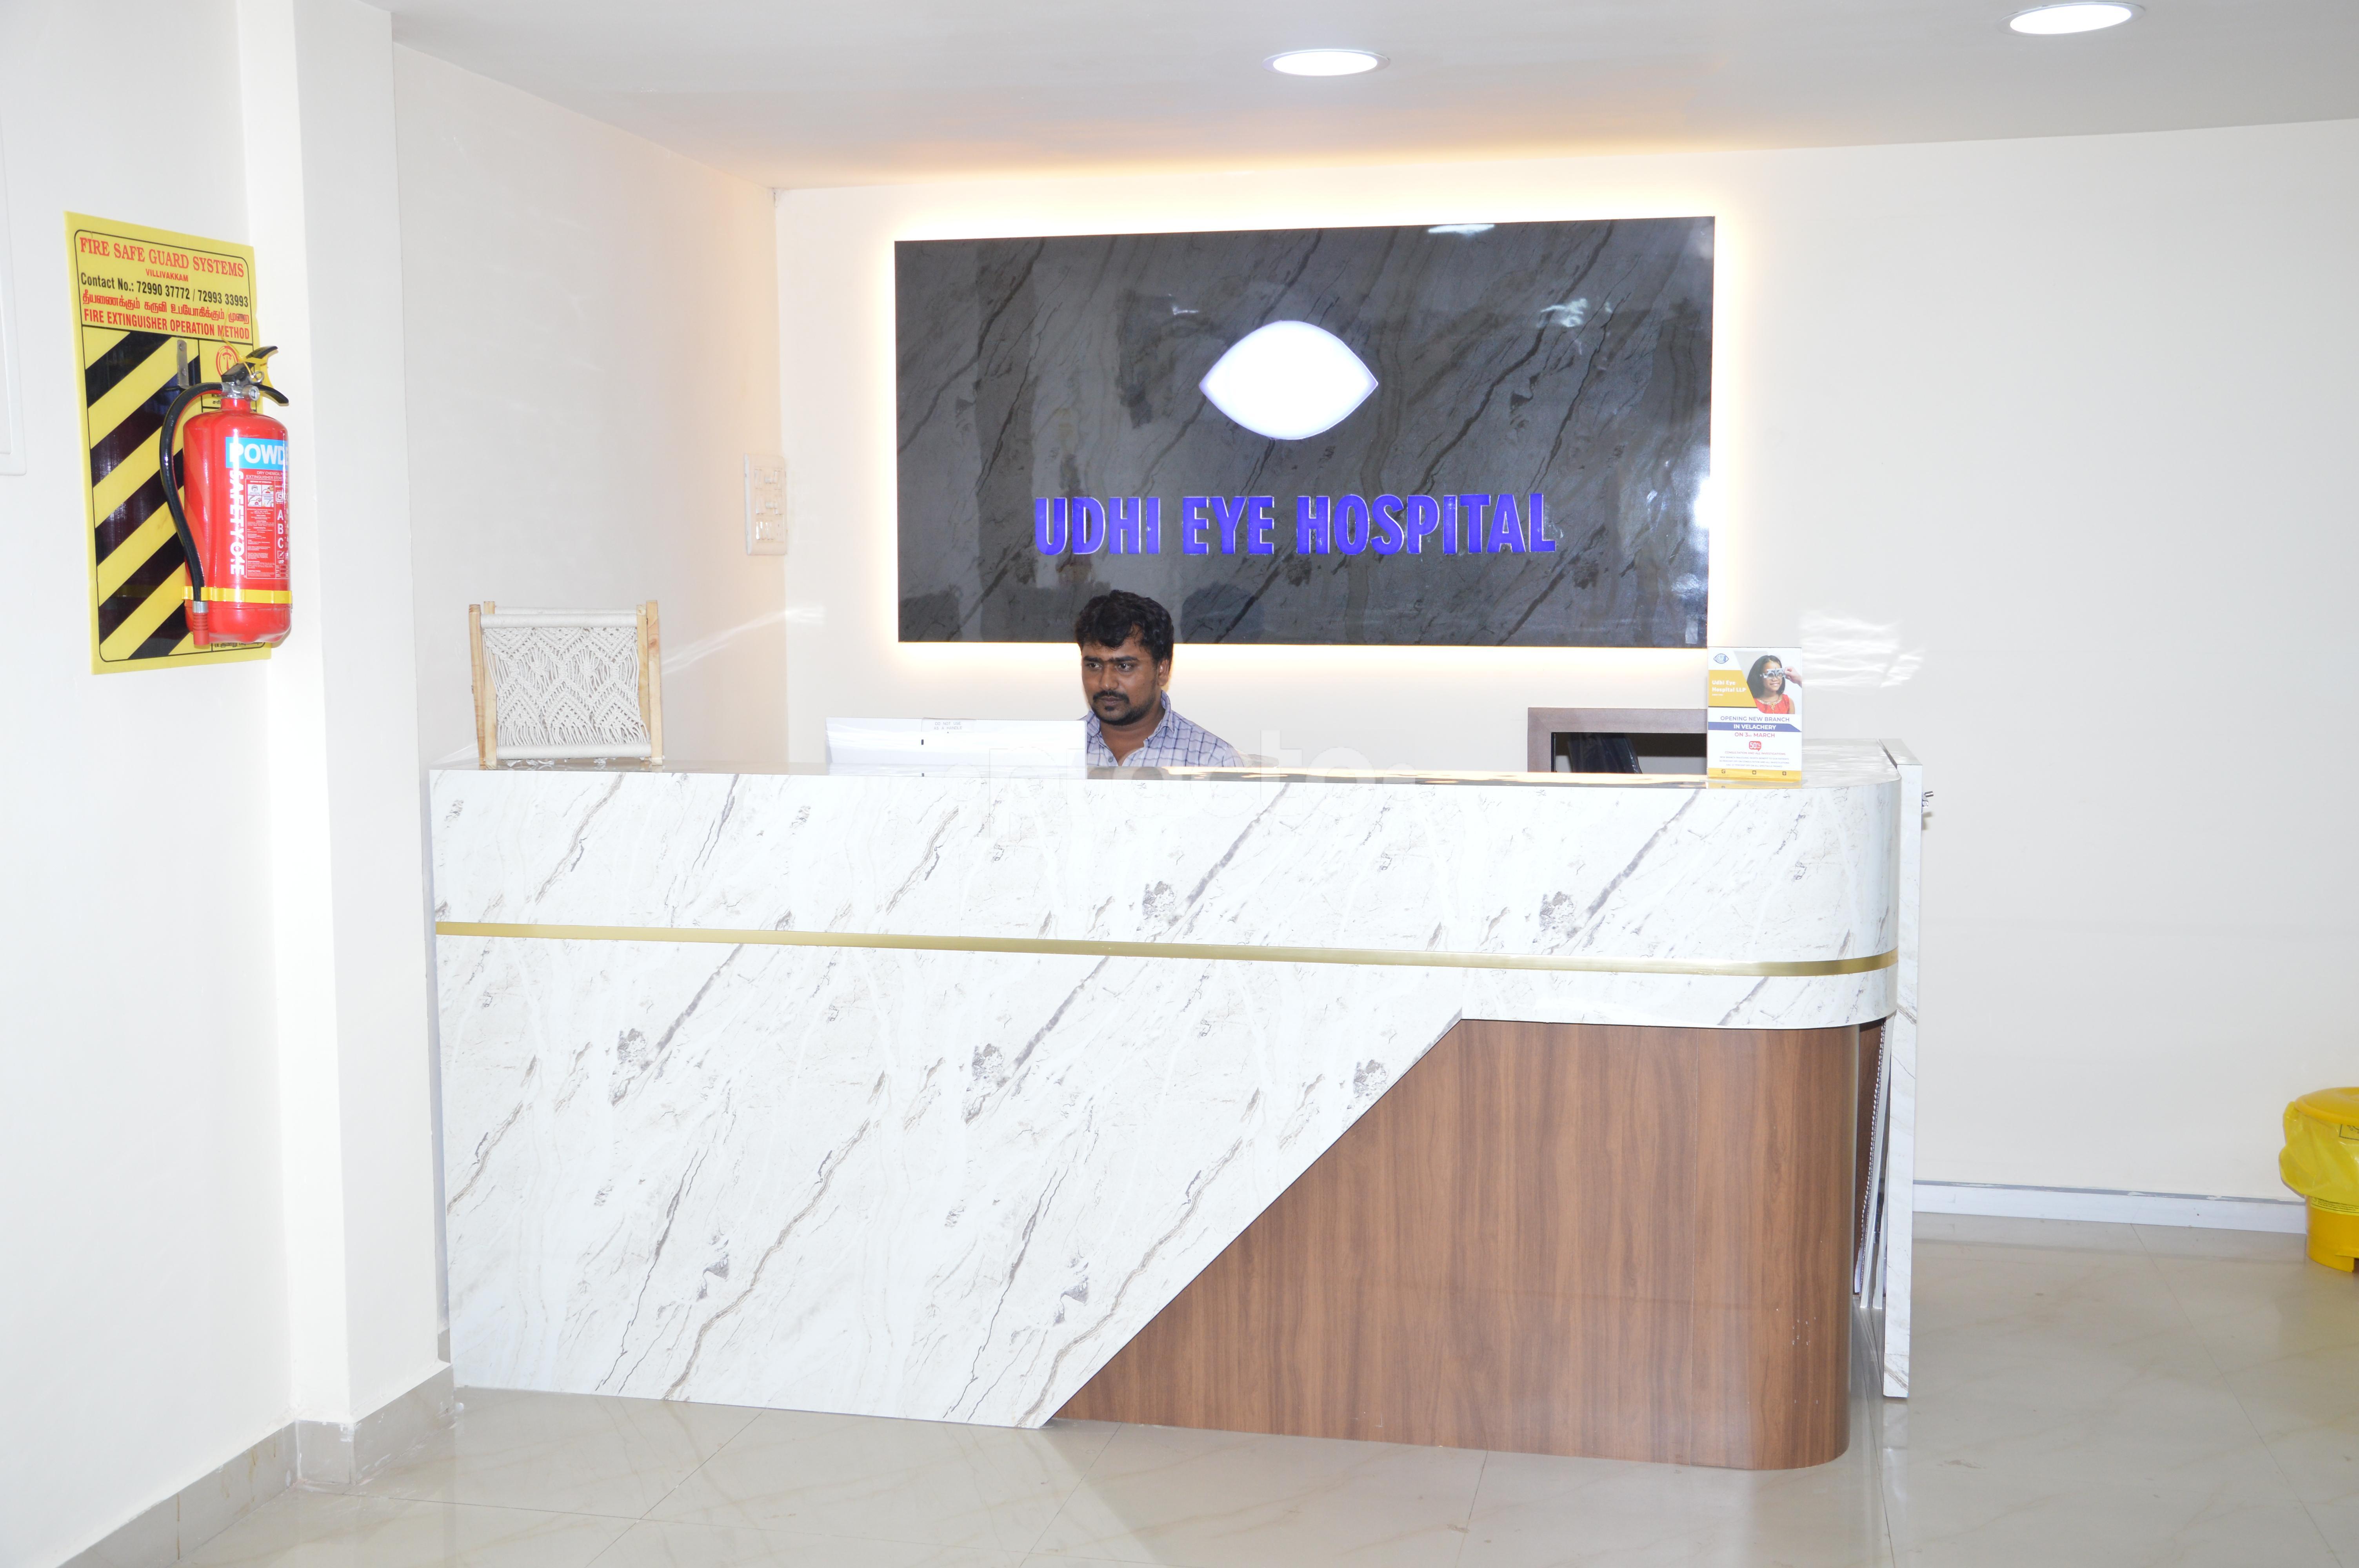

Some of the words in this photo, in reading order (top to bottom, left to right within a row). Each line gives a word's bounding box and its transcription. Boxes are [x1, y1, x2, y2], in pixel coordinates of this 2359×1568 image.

[80, 237, 110, 256] FIRE
[113, 243, 145, 262] SAFE
[149, 249, 189, 269] GUARD
[193, 256, 244, 278] SYSTEMS
[145, 269, 188, 281] VILLIVAKKAM
[81, 272, 115, 289] Contact
[118, 278, 134, 292] No.:
[136, 281, 162, 296] 72990
[165, 285, 190, 300] 37772
[198, 290, 222, 304] 72993
[225, 293, 248, 307] 33993
[144, 301, 167, 314] கருவி
[84, 309, 104, 323] FIRE
[107, 311, 167, 330] EXTINGUISHER
[170, 319, 214, 336] OPERATION
[217, 325, 249, 339] METHOD
[277, 509, 284, 520] A
[278, 523, 284, 534] B
[1035, 497, 1160, 555] UDHI
[1183, 496, 1274, 555] EYE
[1297, 493, 1556, 555] HOSPITAL
[278, 537, 284, 548] C
